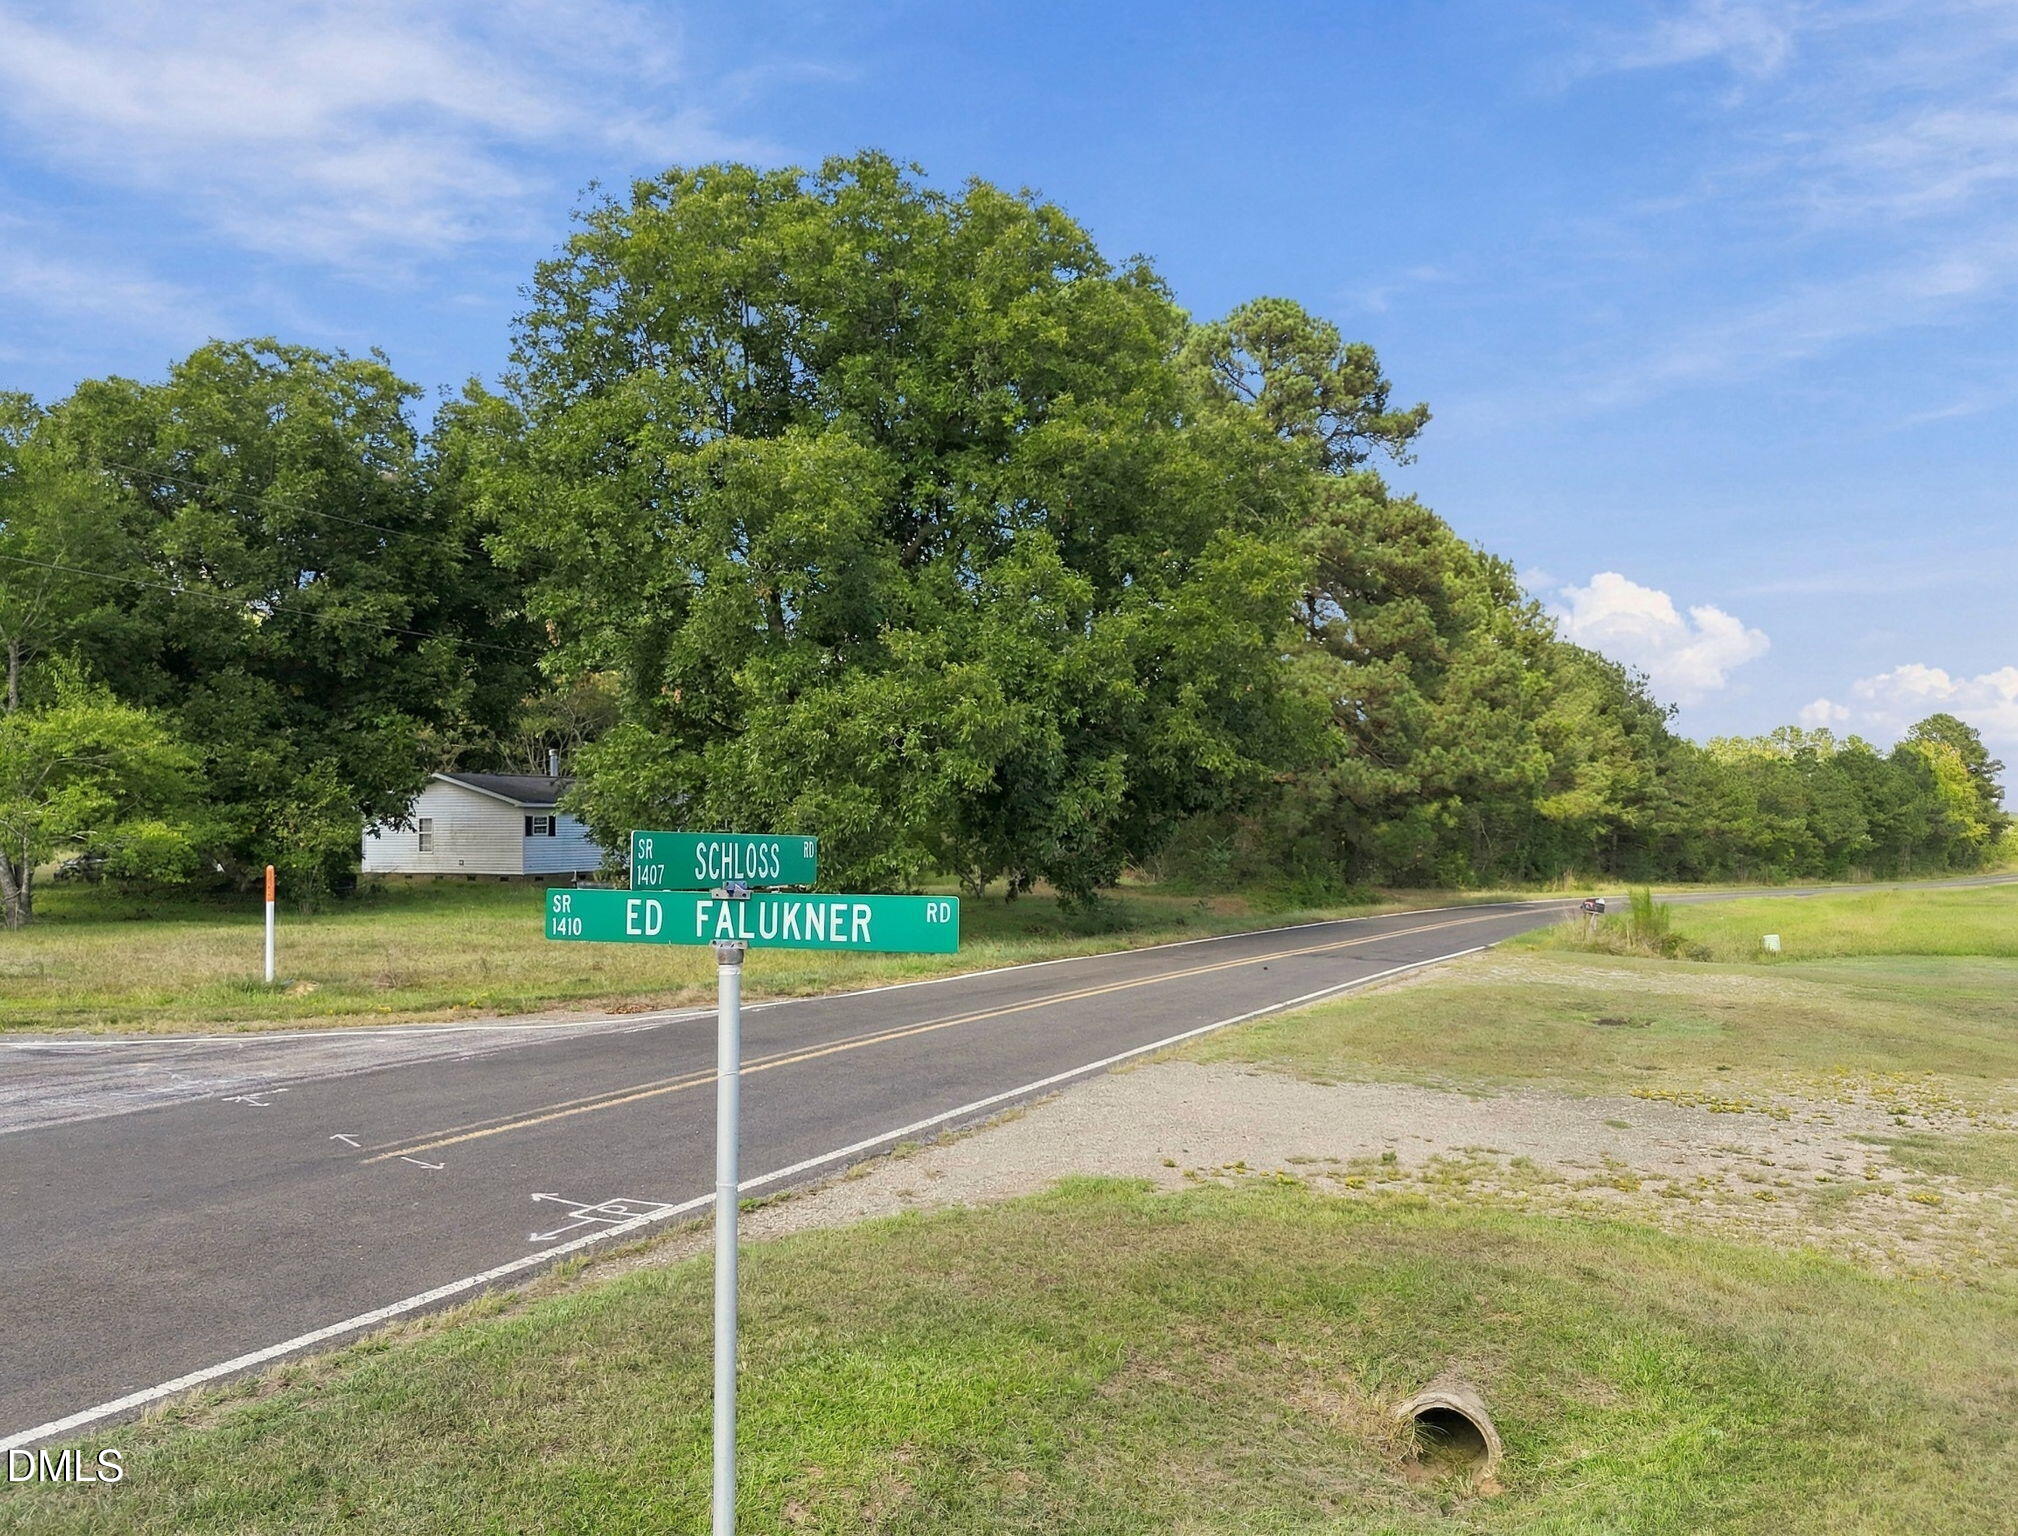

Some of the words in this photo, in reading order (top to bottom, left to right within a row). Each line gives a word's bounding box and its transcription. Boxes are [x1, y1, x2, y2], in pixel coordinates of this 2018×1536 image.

[638, 839, 653, 860] SR
[695, 842, 780, 880] SCHLOSS
[803, 841, 814, 859] RD
[637, 864, 665, 886] 1407
[552, 894, 571, 914] SR
[552, 917, 582, 937] 1410
[626, 899, 663, 936] ED
[696, 900, 872, 943] FALUKNER
[926, 903, 951, 924] RD
